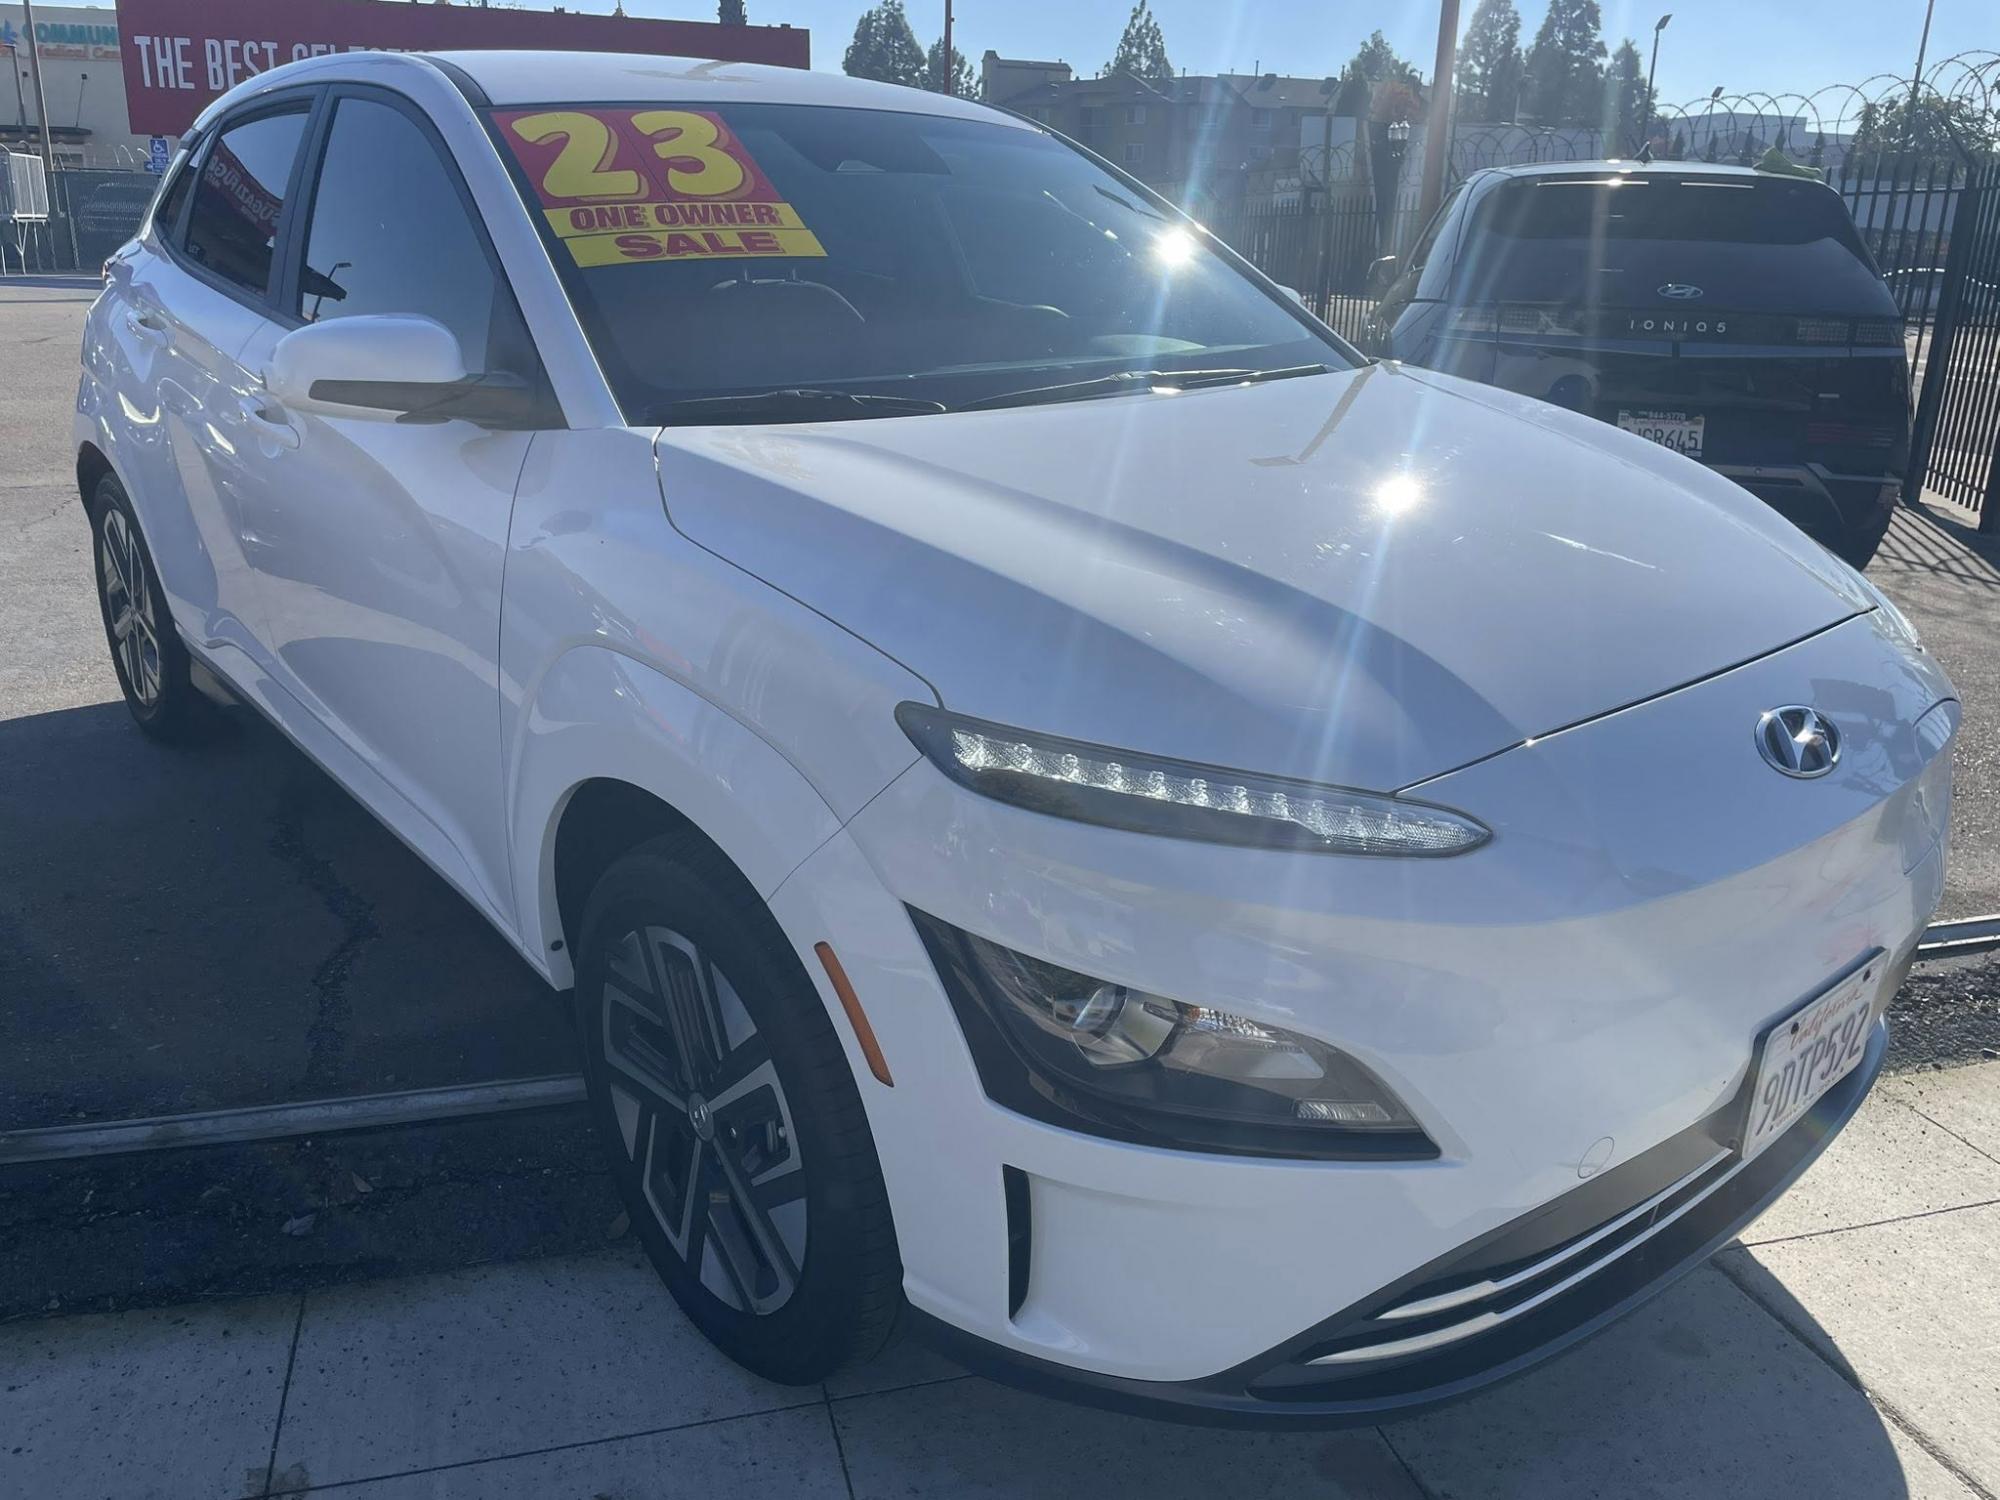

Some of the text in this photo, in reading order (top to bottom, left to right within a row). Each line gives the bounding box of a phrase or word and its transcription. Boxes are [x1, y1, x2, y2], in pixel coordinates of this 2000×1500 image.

[134, 35, 278, 91] THE BEST
[511, 110, 750, 200] 23
[570, 204, 784, 231] ONE OWNER
[615, 231, 786, 259] SALE
[1755, 1001, 1871, 1137] 9DTP592
